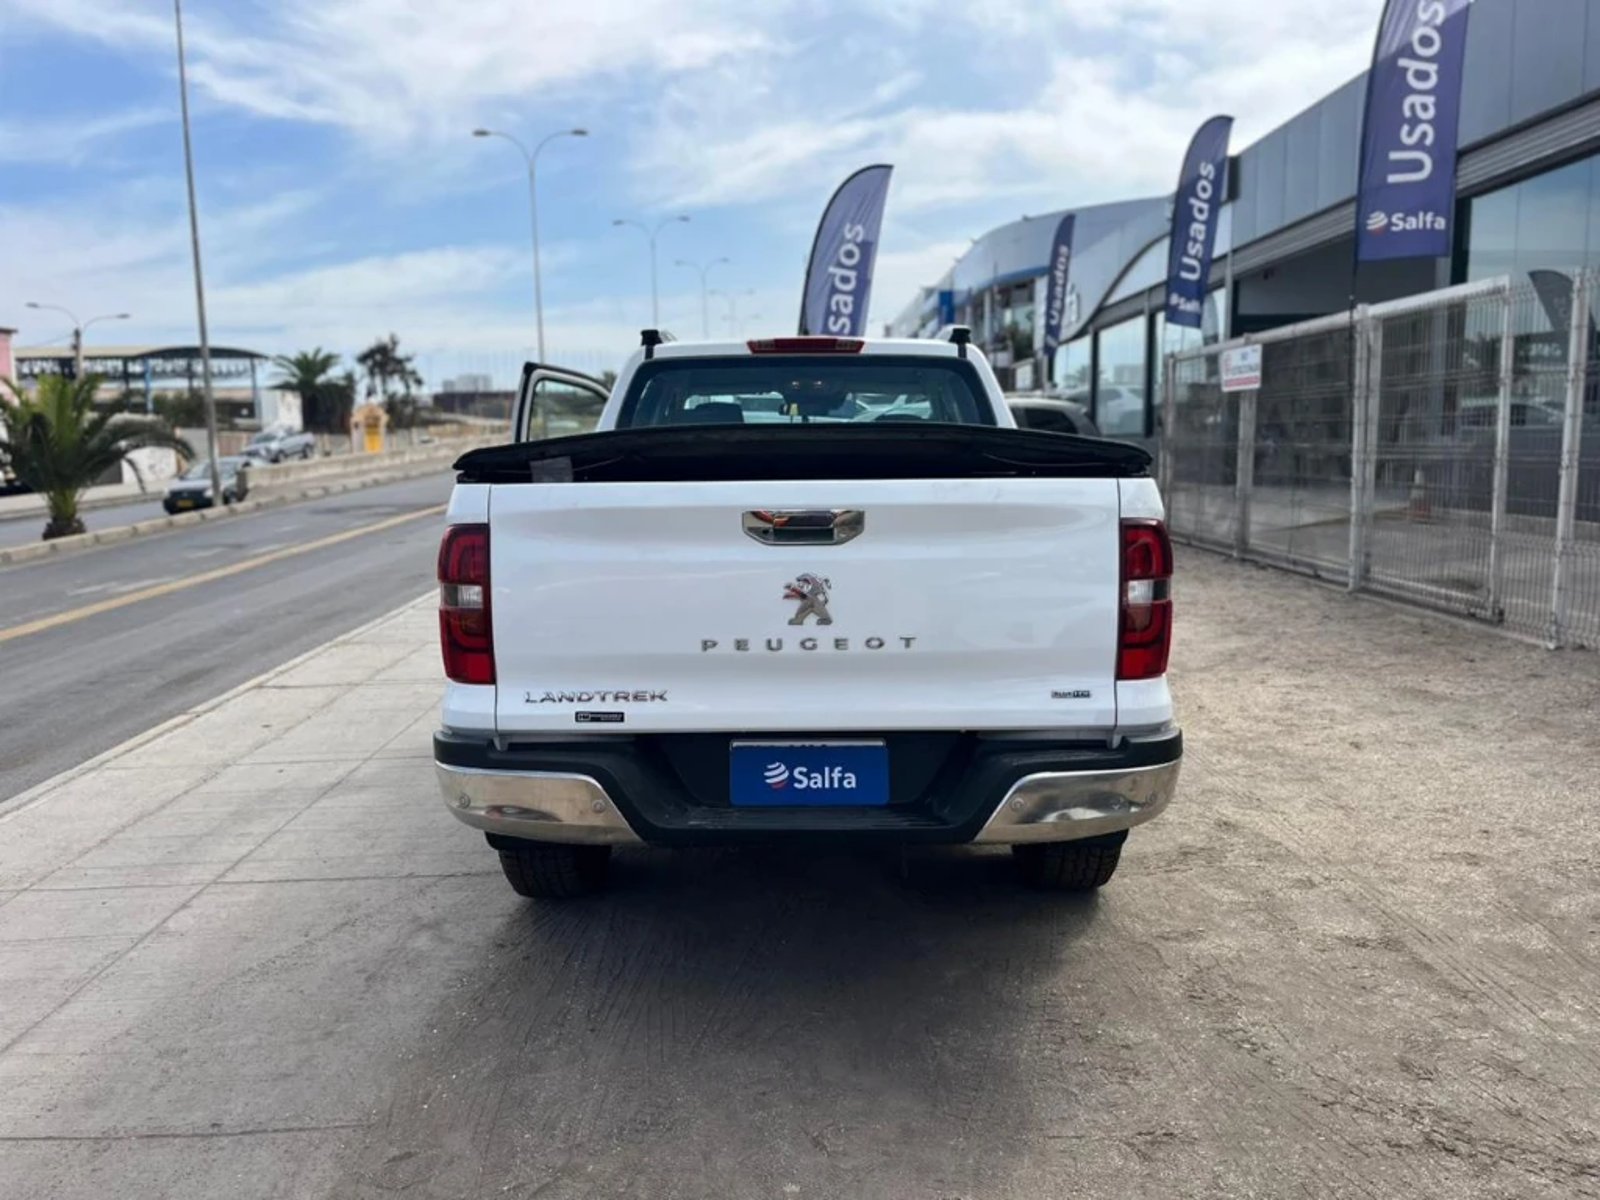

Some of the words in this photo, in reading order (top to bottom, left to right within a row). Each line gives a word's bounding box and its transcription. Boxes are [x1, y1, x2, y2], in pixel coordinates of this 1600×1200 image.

[1387, 0, 1446, 183] Usados
[1179, 161, 1215, 281] Usados
[1390, 211, 1446, 231] Salfa
[828, 222, 865, 336] sados
[701, 637, 916, 651] PEUGEOT
[525, 690, 669, 703] LANDTREK
[793, 766, 856, 789] Salfa
